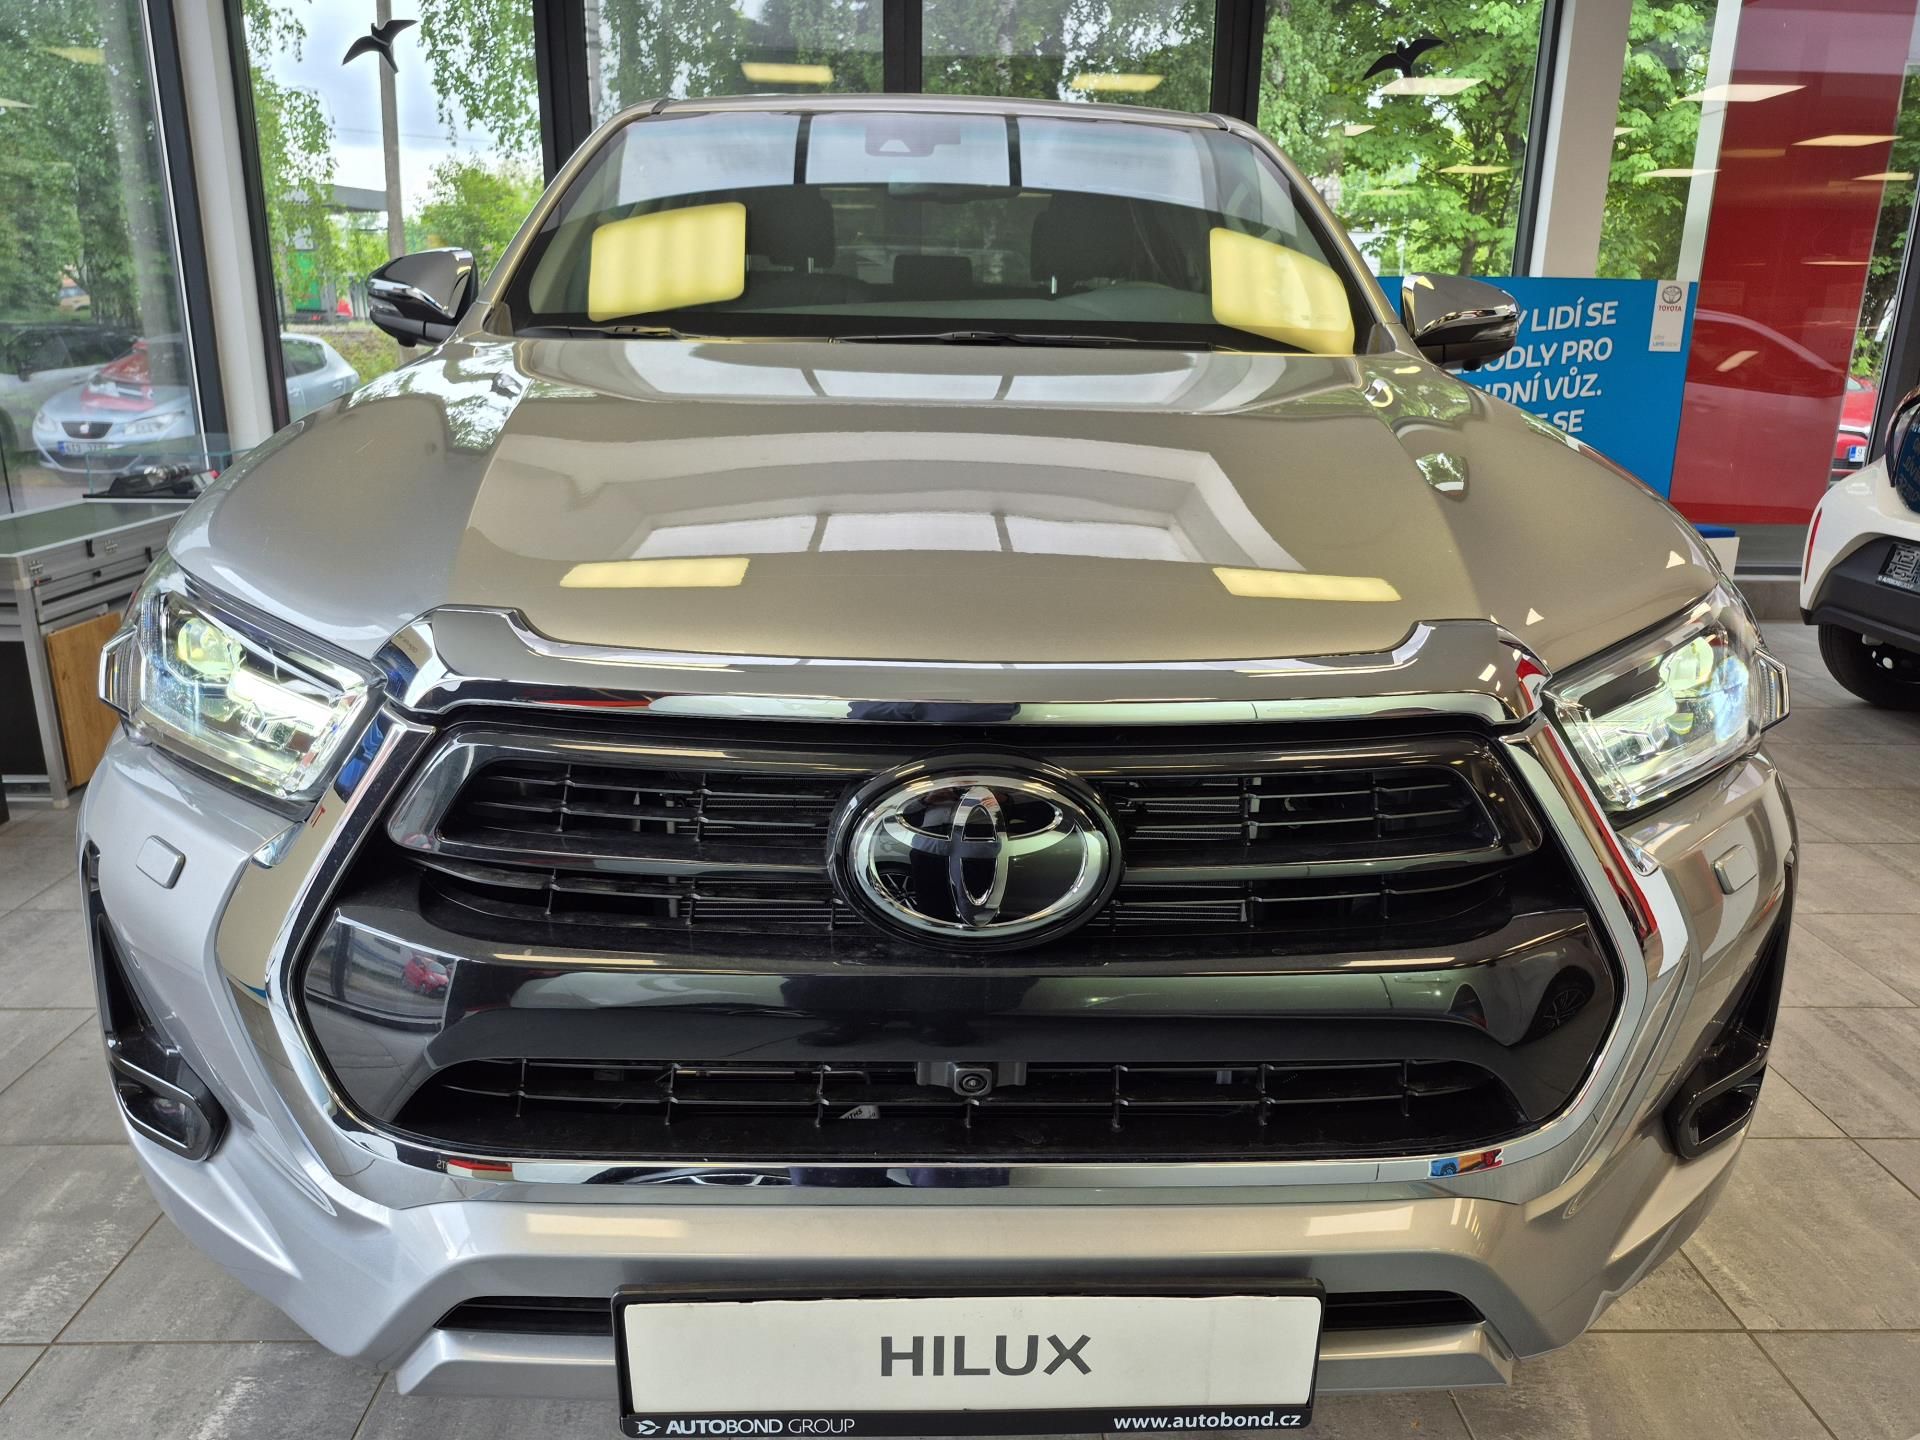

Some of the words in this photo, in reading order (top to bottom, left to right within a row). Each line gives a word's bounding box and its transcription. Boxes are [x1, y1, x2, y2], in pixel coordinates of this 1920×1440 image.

[1531, 296, 1584, 332] LIDÍ
[1585, 300, 1619, 328] SE
[1561, 337, 1613, 364] PRO
[1544, 366, 1602, 401] VŮZ.
[1552, 409, 1585, 433] SE
[881, 1334, 1091, 1376] HILUX
[666, 1418, 782, 1434] AUTOBOND
[788, 1418, 855, 1434] GROUP
[1113, 1411, 1301, 1429] www.autobond.cz
